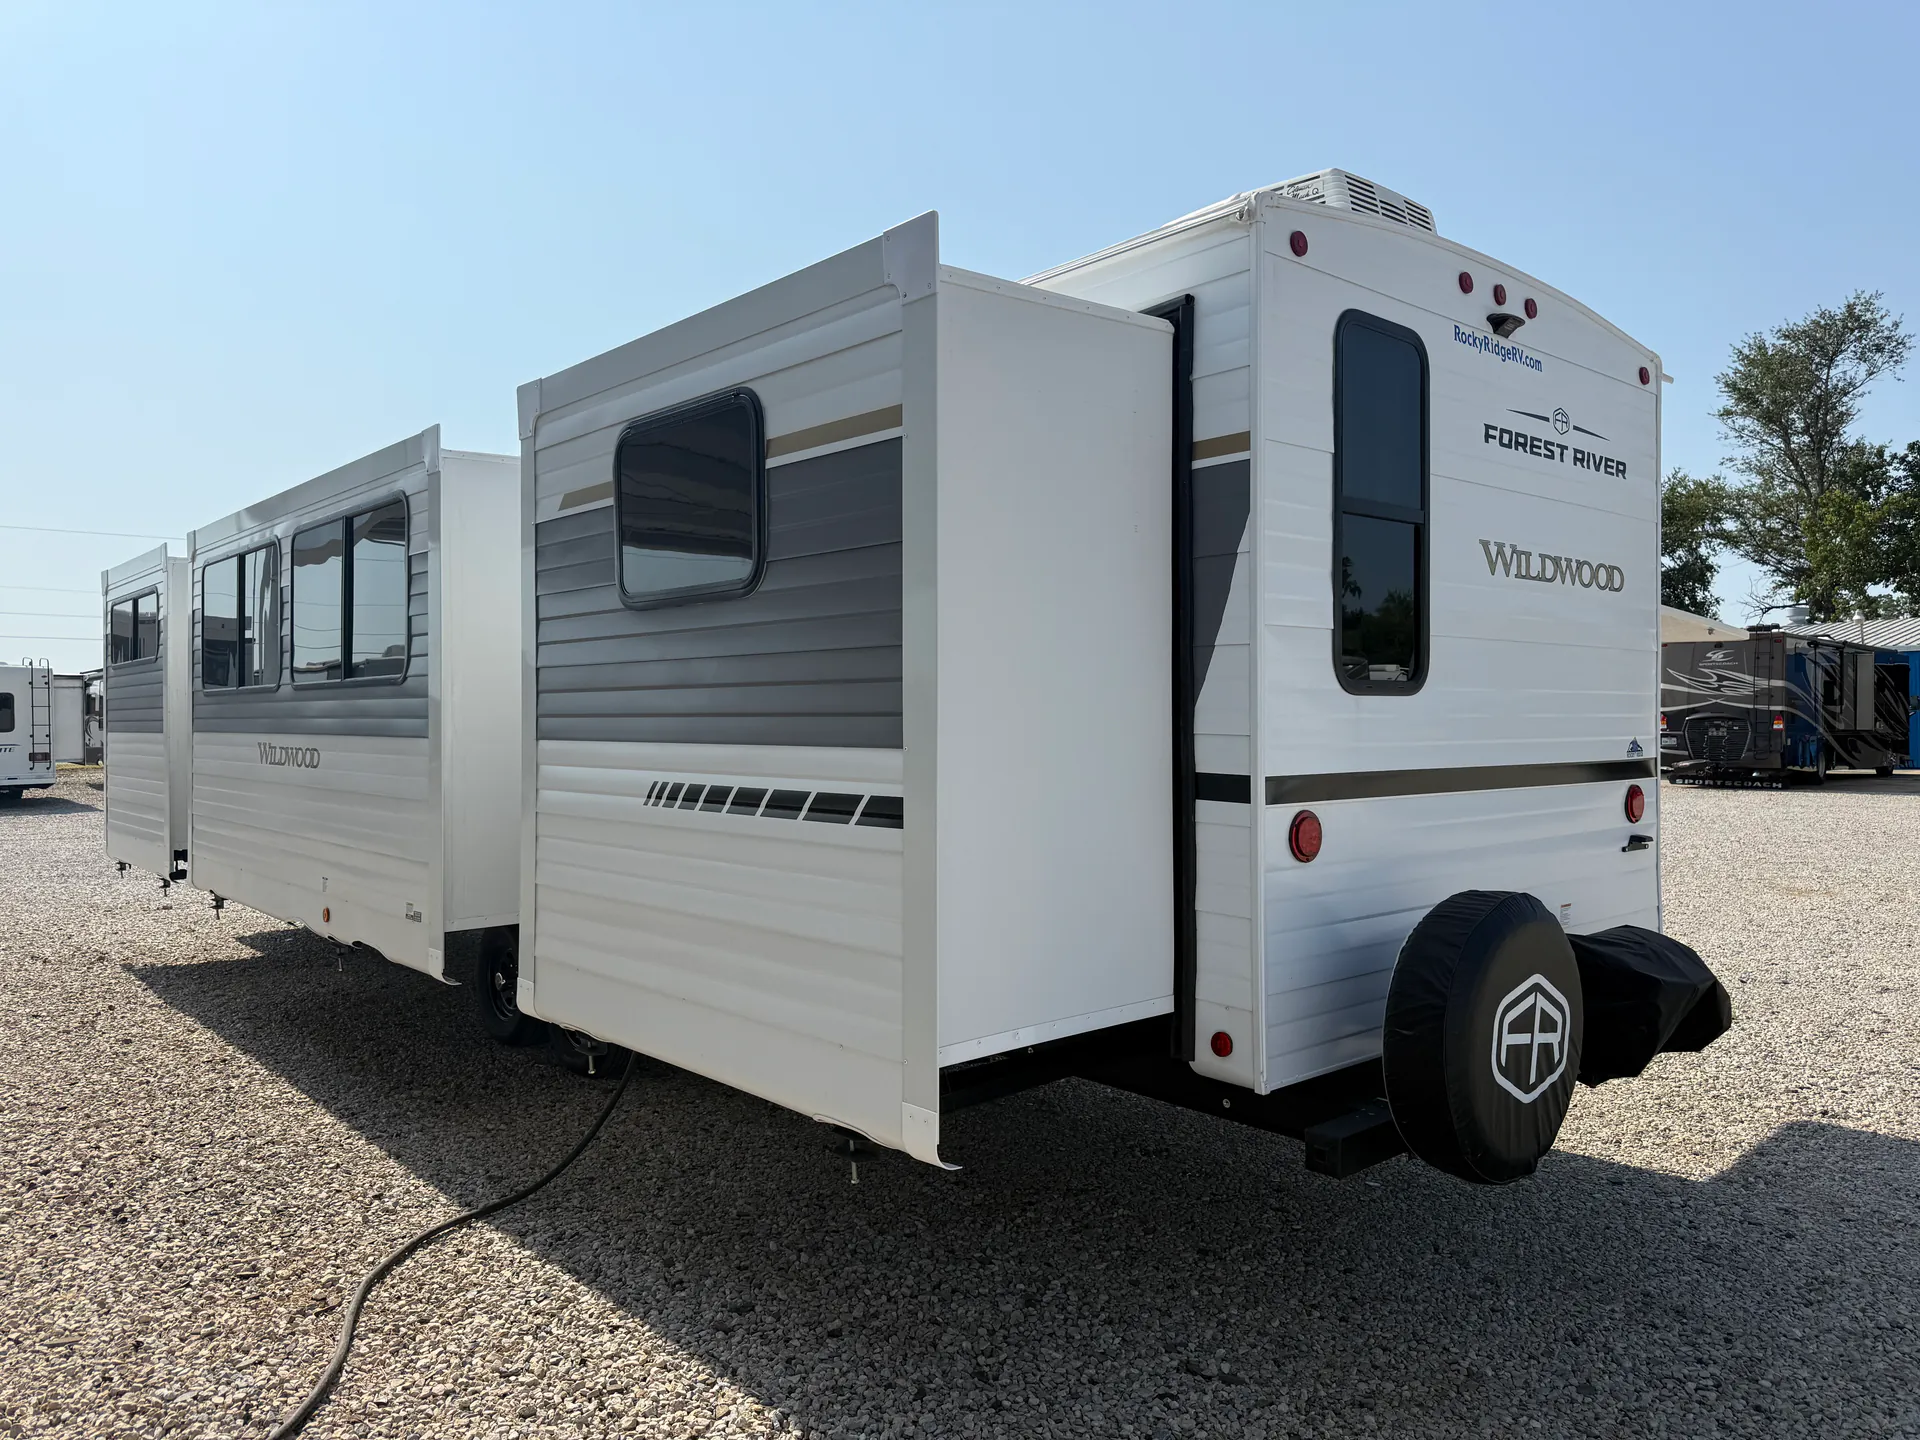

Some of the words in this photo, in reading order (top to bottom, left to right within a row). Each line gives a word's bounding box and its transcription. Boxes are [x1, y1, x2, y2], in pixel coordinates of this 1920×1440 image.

[1454, 324, 1543, 373] RockyRidgeRV.com
[1483, 423, 1568, 463] FOREST
[1573, 447, 1627, 480] RIVER
[1479, 538, 1625, 592] WILDWOOD
[257, 741, 320, 769] WILDWOOD
[1675, 778, 1782, 789] SPORTSCOACH
